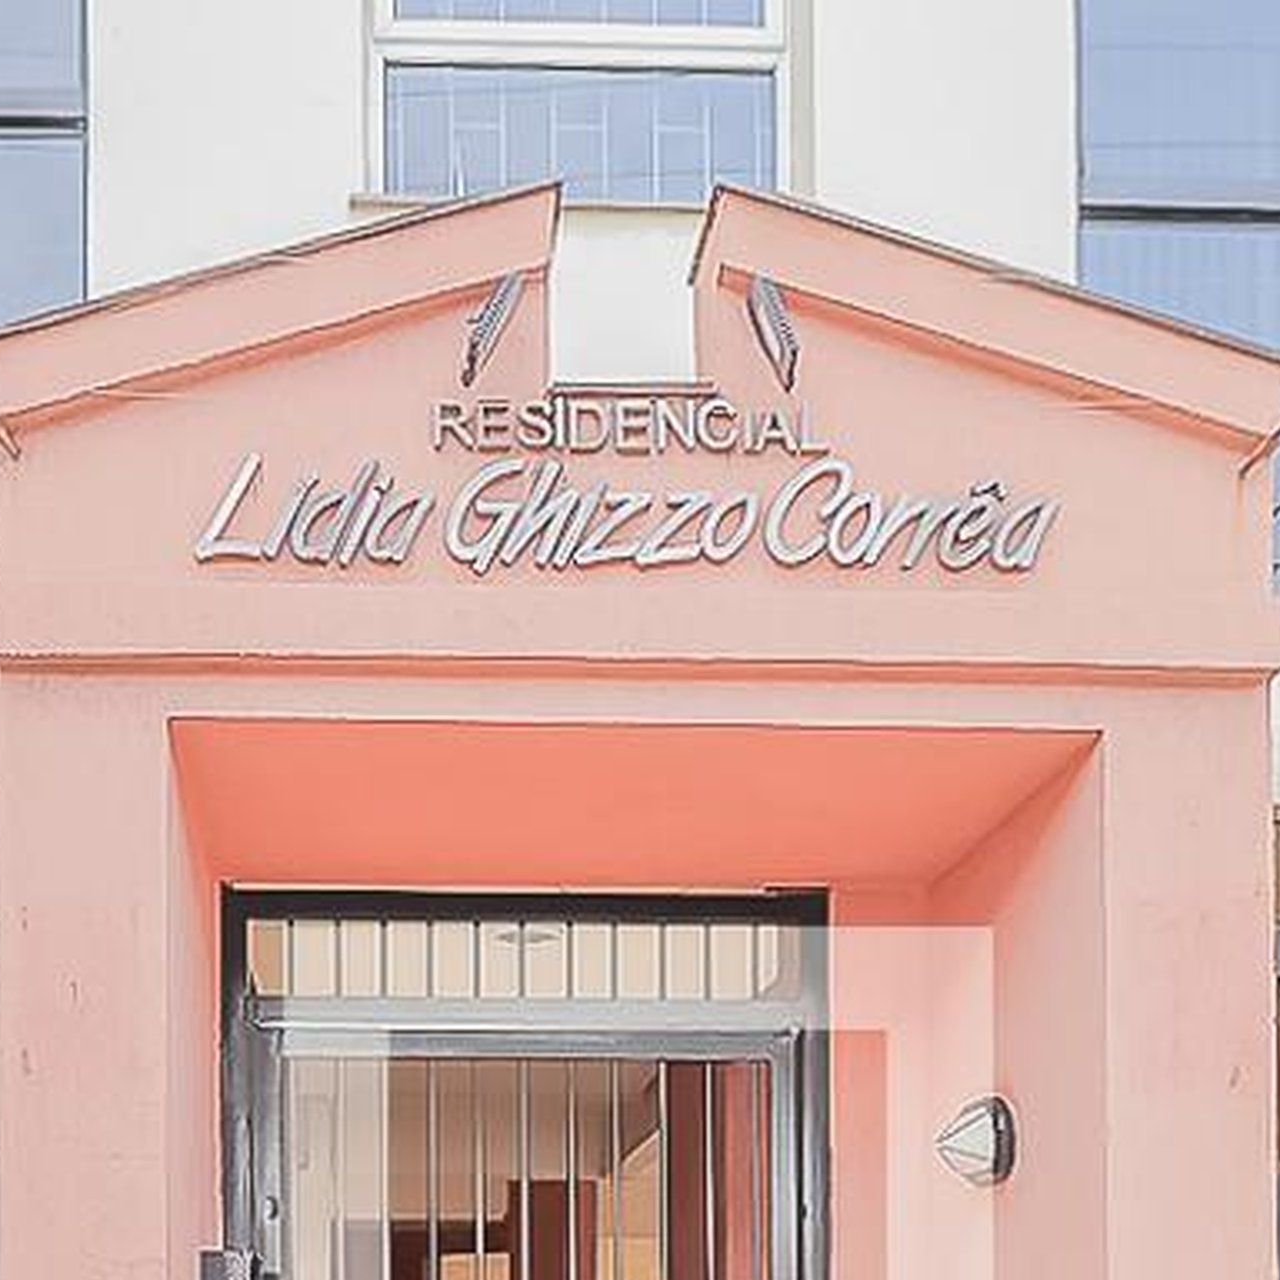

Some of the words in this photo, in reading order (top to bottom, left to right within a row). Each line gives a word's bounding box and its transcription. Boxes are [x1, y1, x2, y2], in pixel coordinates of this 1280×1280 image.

[433, 396, 830, 453] RESIDENCIAL
[445, 457, 760, 577] Ghizzo
[763, 457, 1060, 571] Corrêa
